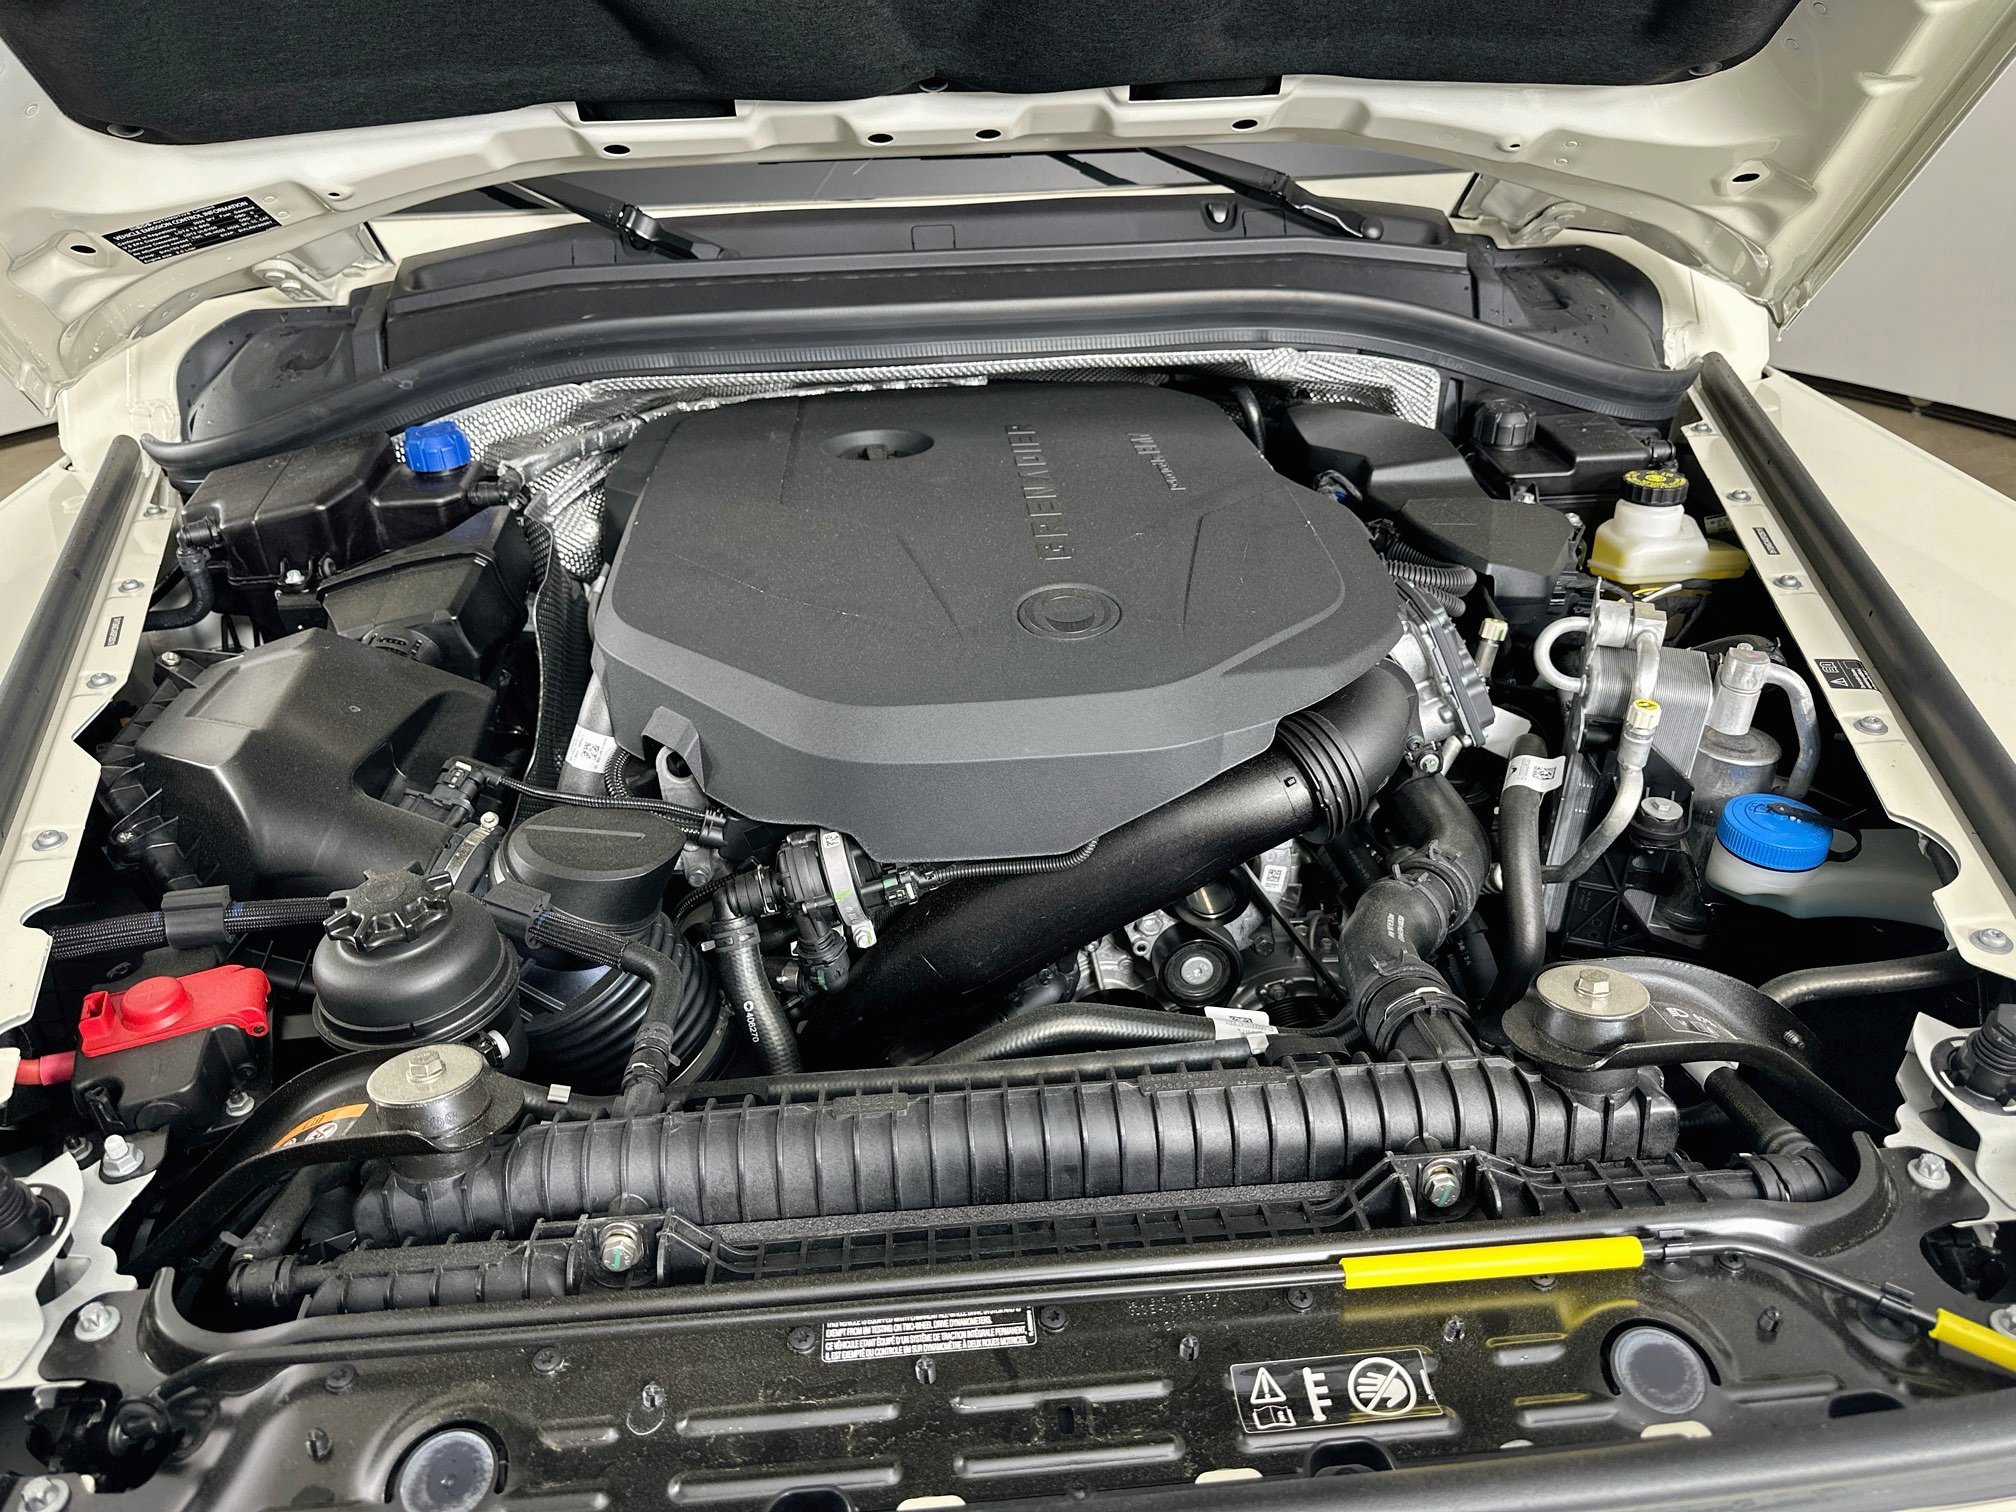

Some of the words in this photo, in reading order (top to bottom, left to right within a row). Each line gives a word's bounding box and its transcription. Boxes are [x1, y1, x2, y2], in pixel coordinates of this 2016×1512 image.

[112, 230, 141, 241] VEHICLE
[140, 222, 173, 235] EMISSION
[171, 213, 204, 225] CONTROL
[202, 200, 249, 217] INFORMATION
[1005, 424, 1075, 561] GRENADIER
[746, 1012, 760, 1043] 406270
[825, 1327, 847, 1338] EXEMPT
[846, 1326, 863, 1336] FROM
[871, 1323, 893, 1334] TESTING
[893, 1323, 903, 1332] ON
[902, 1320, 934, 1331] TWO-WHEEL
[933, 1319, 950, 1328] DRIVE
[932, 1332, 941, 1342] DE
[940, 1330, 967, 1340] TRACTION
